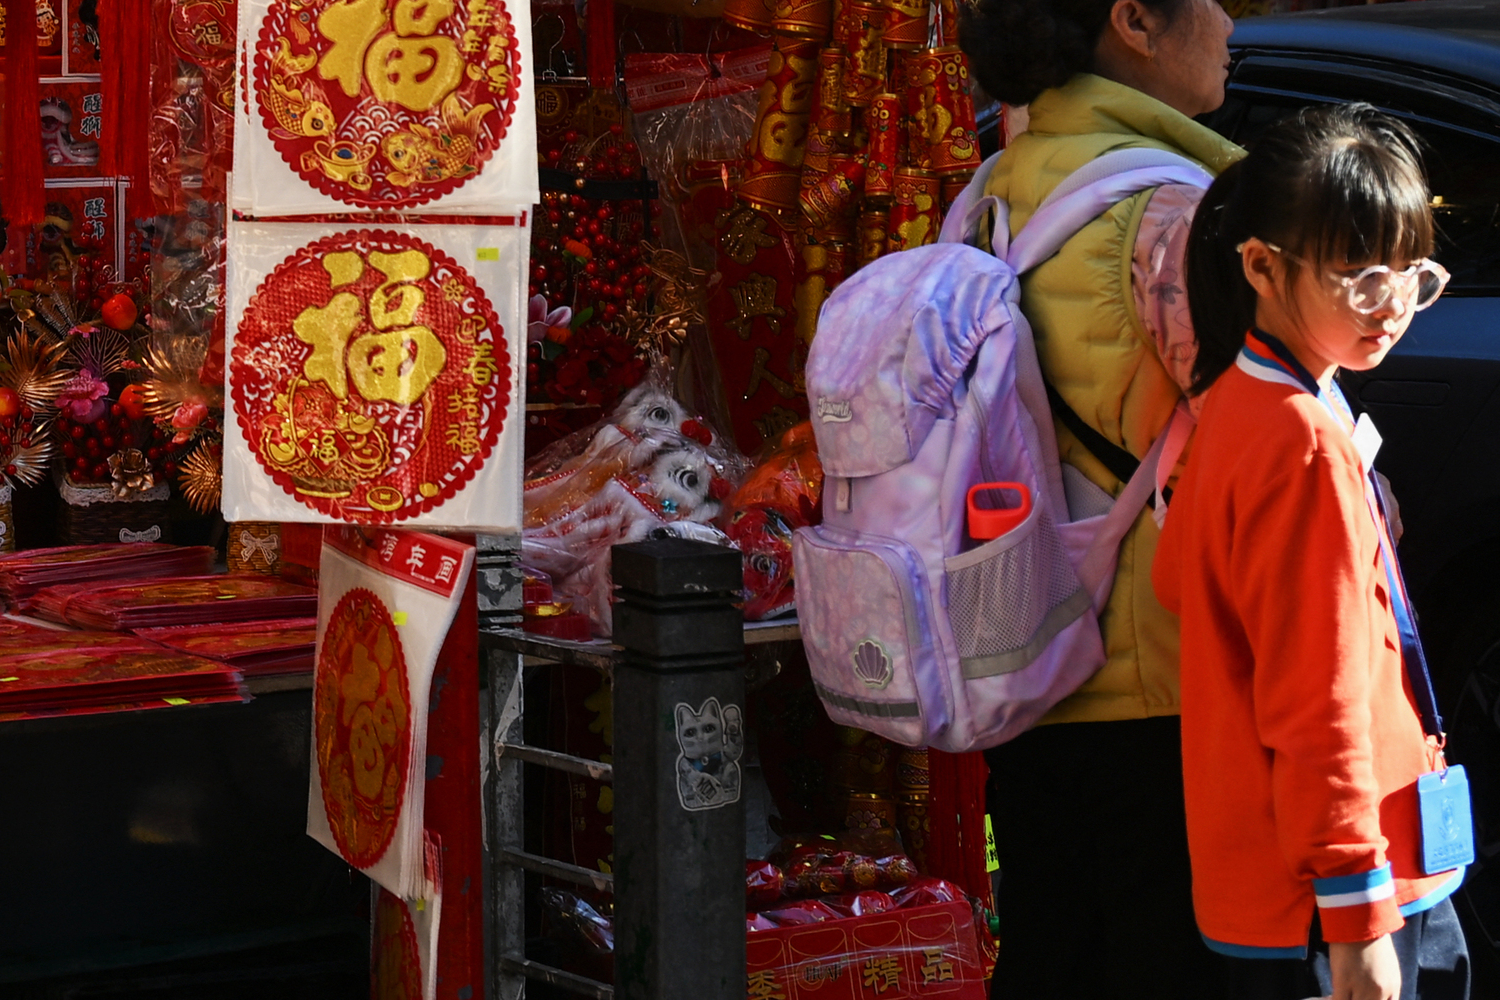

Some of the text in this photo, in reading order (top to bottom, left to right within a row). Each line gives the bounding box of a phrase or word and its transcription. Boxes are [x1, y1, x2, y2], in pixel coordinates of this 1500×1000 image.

[194, 21, 224, 47] 福
[293, 250, 447, 407] 福
[308, 428, 340, 463] 福
[863, 948, 955, 996] 精品
